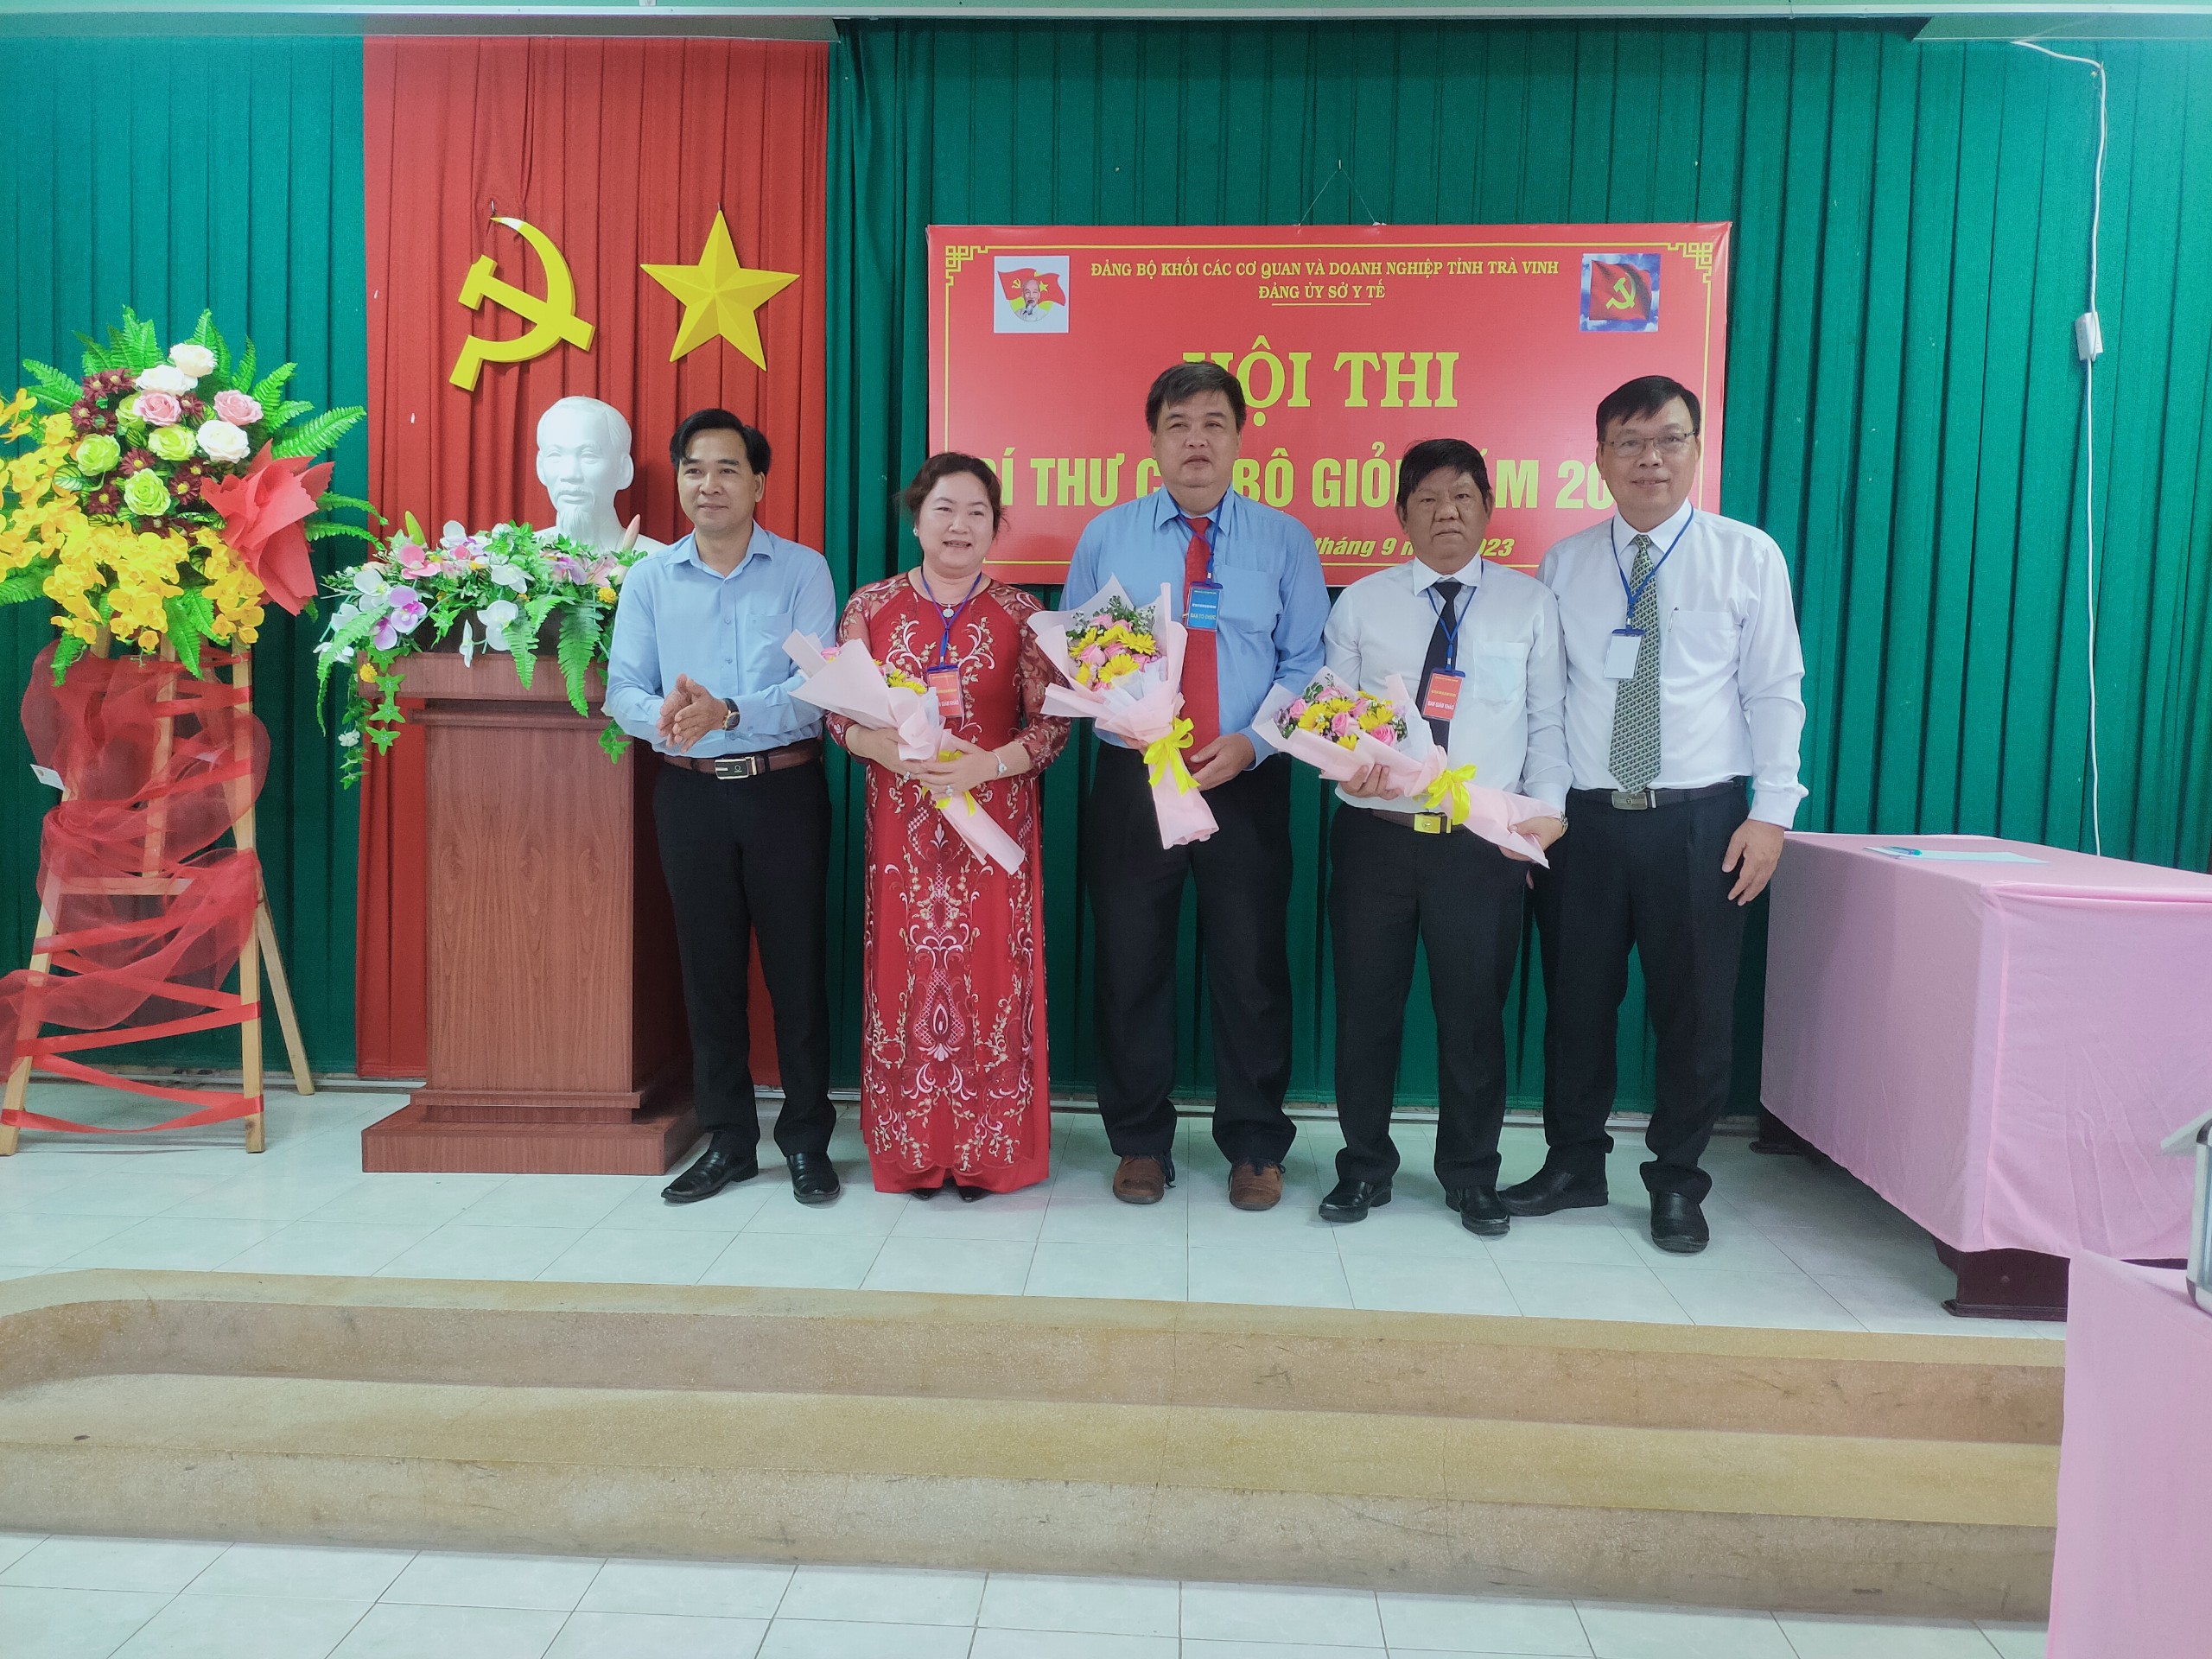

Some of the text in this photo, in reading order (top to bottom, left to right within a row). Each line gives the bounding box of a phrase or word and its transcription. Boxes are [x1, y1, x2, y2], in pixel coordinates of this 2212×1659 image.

[1091, 257, 1559, 279] ĐẢNG BỘ KHỐI CÁC CƠ QUAN VÀ DOANH NGHIỆP TỈNH TRÀ VINH
[1258, 278, 1385, 299] ĐẢNG ỦY SỞ Y TẾ
[1183, 335, 1459, 427] ỘI THI
[980, 447, 1015, 506] Í
[1030, 453, 1125, 506] THƯ
[1555, 460, 1614, 510] 20
[1314, 537, 1376, 557] tháng
[1381, 537, 1397, 556] 9
